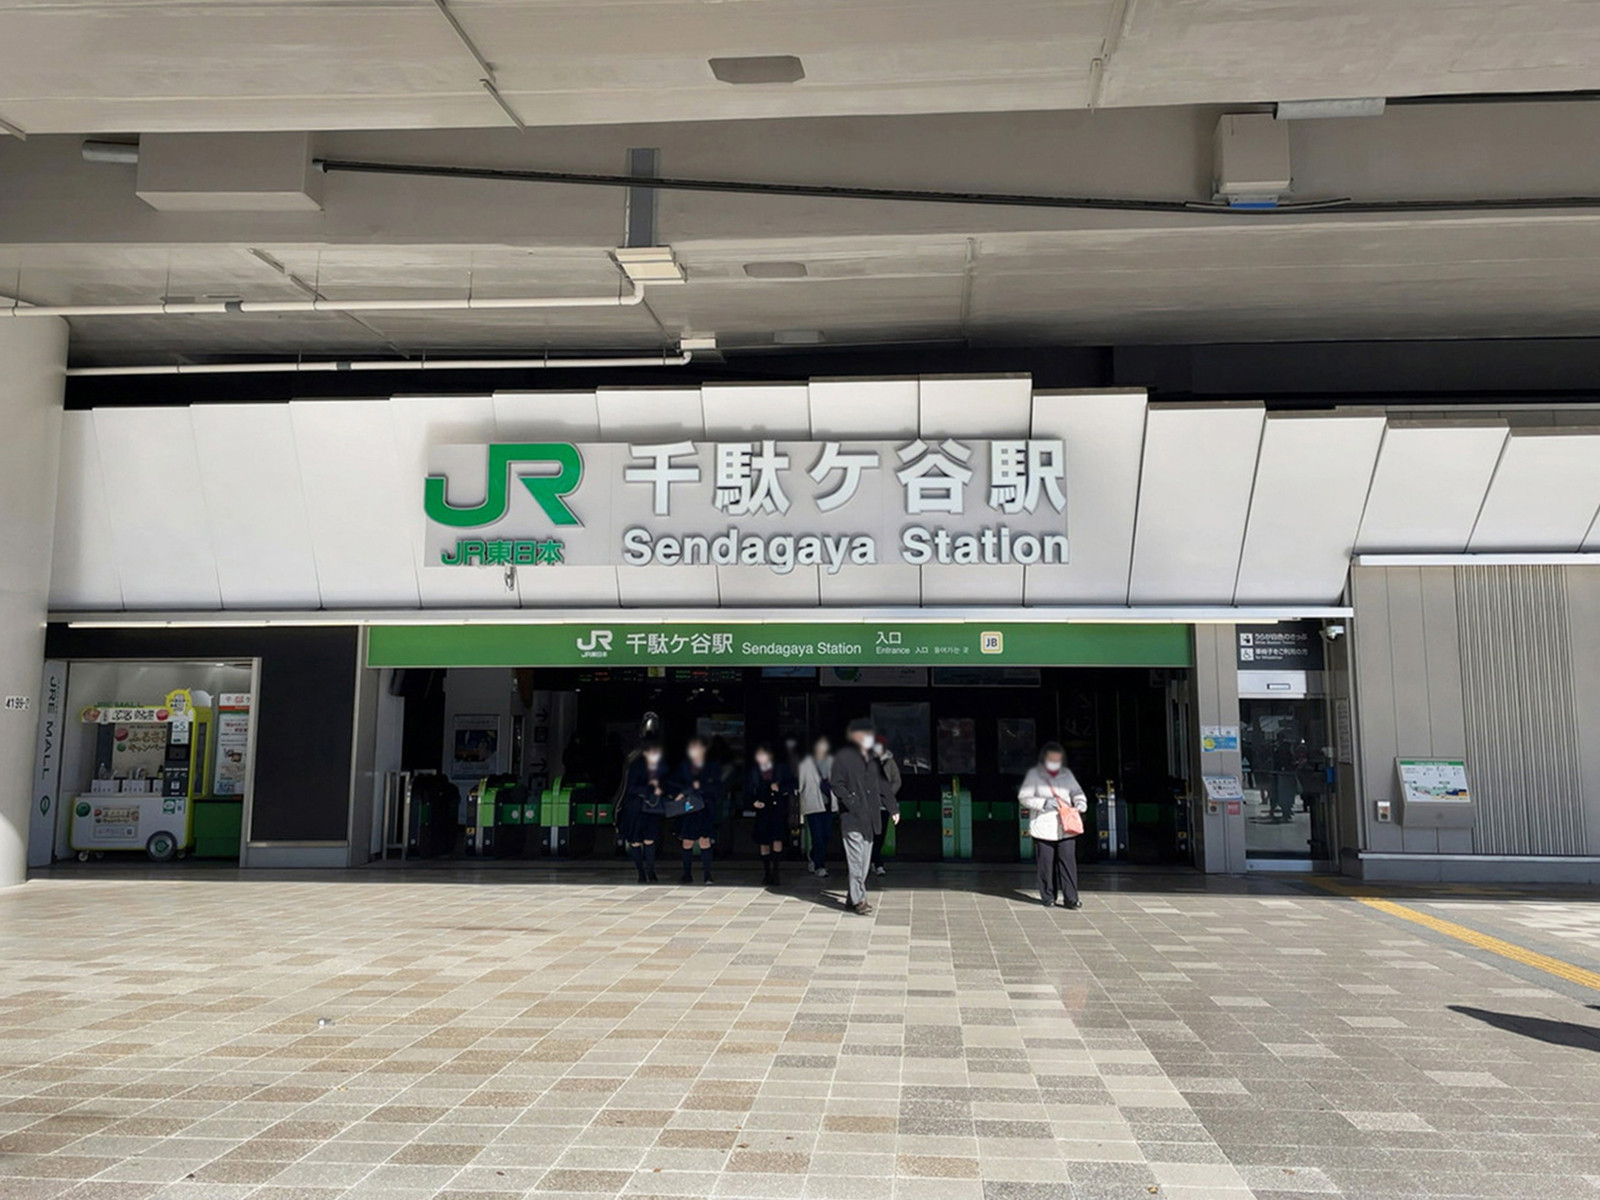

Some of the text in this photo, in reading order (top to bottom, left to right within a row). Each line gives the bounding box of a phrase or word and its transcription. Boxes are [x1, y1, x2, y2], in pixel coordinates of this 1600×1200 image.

[424, 442, 583, 527] JR
[625, 438, 1067, 516] 千駄ケ谷駅
[441, 539, 564, 566] JR東日本
[624, 525, 1069, 574] Sendagaya Station
[577, 630, 613, 650] JR
[626, 632, 733, 654] 千駄ケ谷駅
[742, 641, 862, 657] Sendagaya Station
[876, 632, 901, 645] 入口
[986, 638, 998, 648] JB
[876, 646, 911, 655] Entrance
[42, 721, 53, 780] MALL
